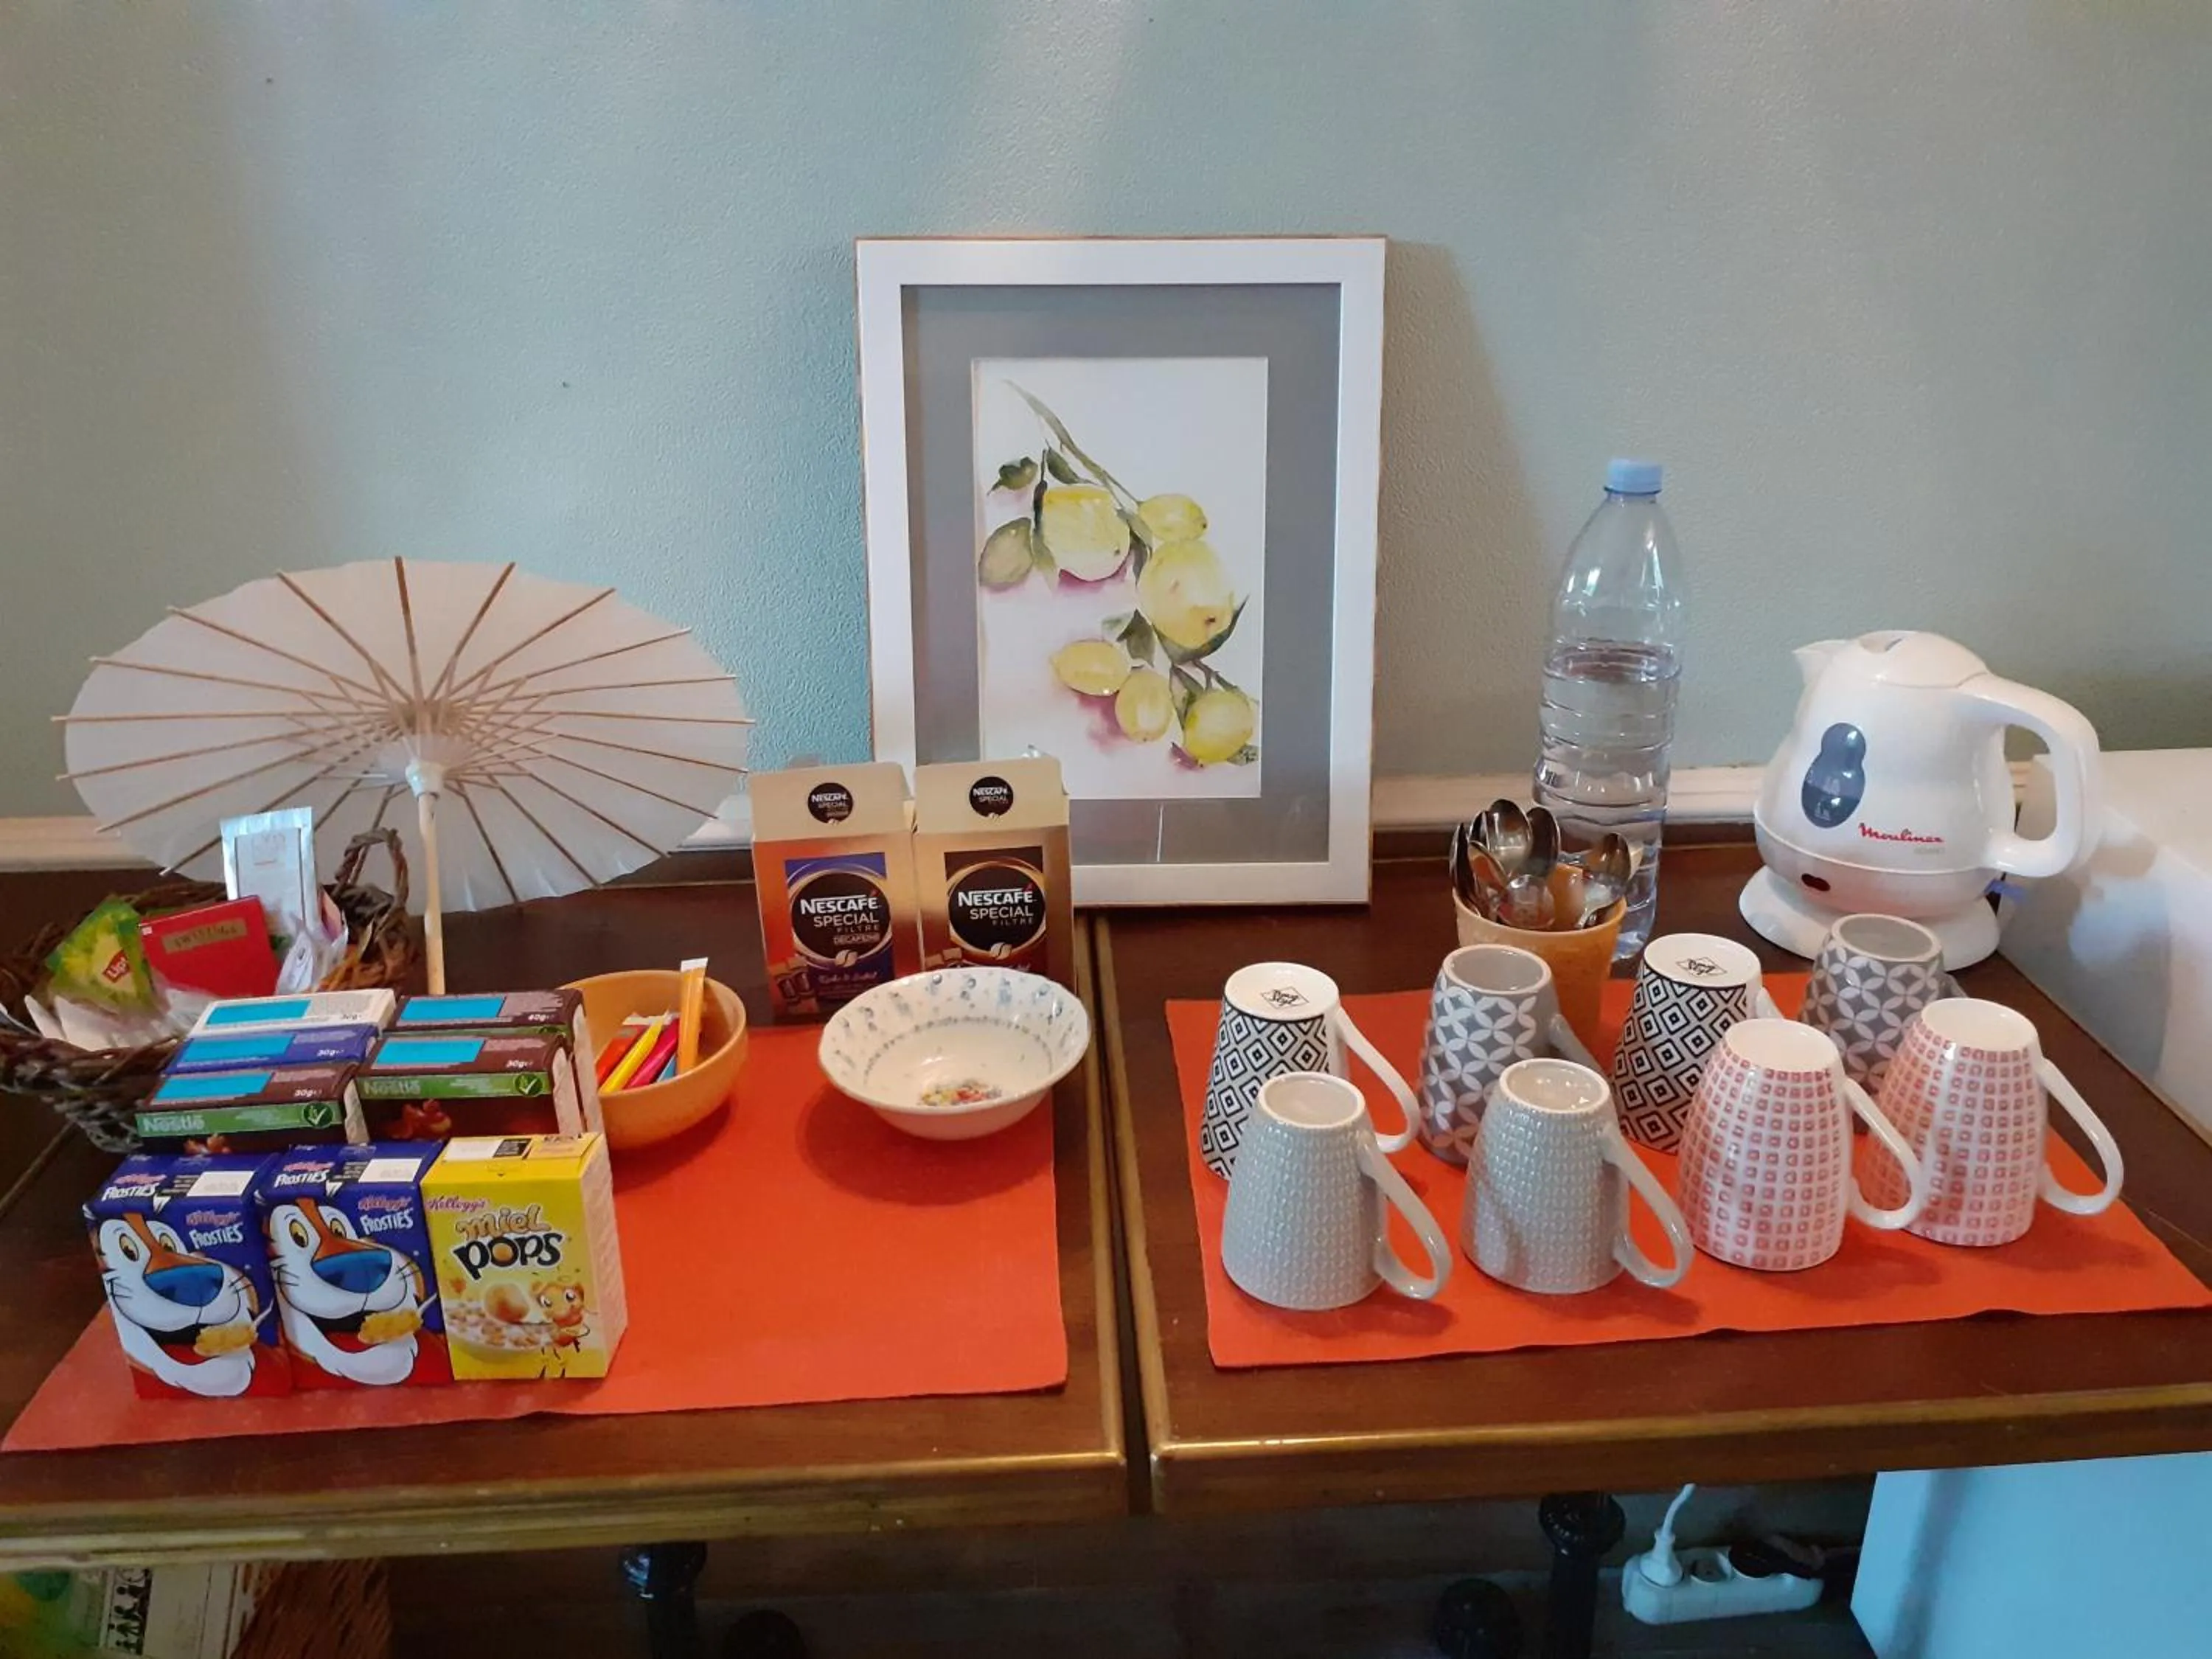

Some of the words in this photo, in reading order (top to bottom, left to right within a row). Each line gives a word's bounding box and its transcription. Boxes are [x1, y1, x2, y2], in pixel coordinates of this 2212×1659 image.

[813, 912, 880, 928] SPECIAL
[970, 905, 1034, 920] SPECIAL
[837, 924, 880, 933] FILTRE
[274, 1169, 330, 1189] FROSTIES
[101, 1182, 160, 1202] FROSTIES
[428, 1194, 487, 1213] Kellogg's
[359, 1208, 414, 1235] FROSTIES
[189, 1222, 243, 1250] FROSTIES
